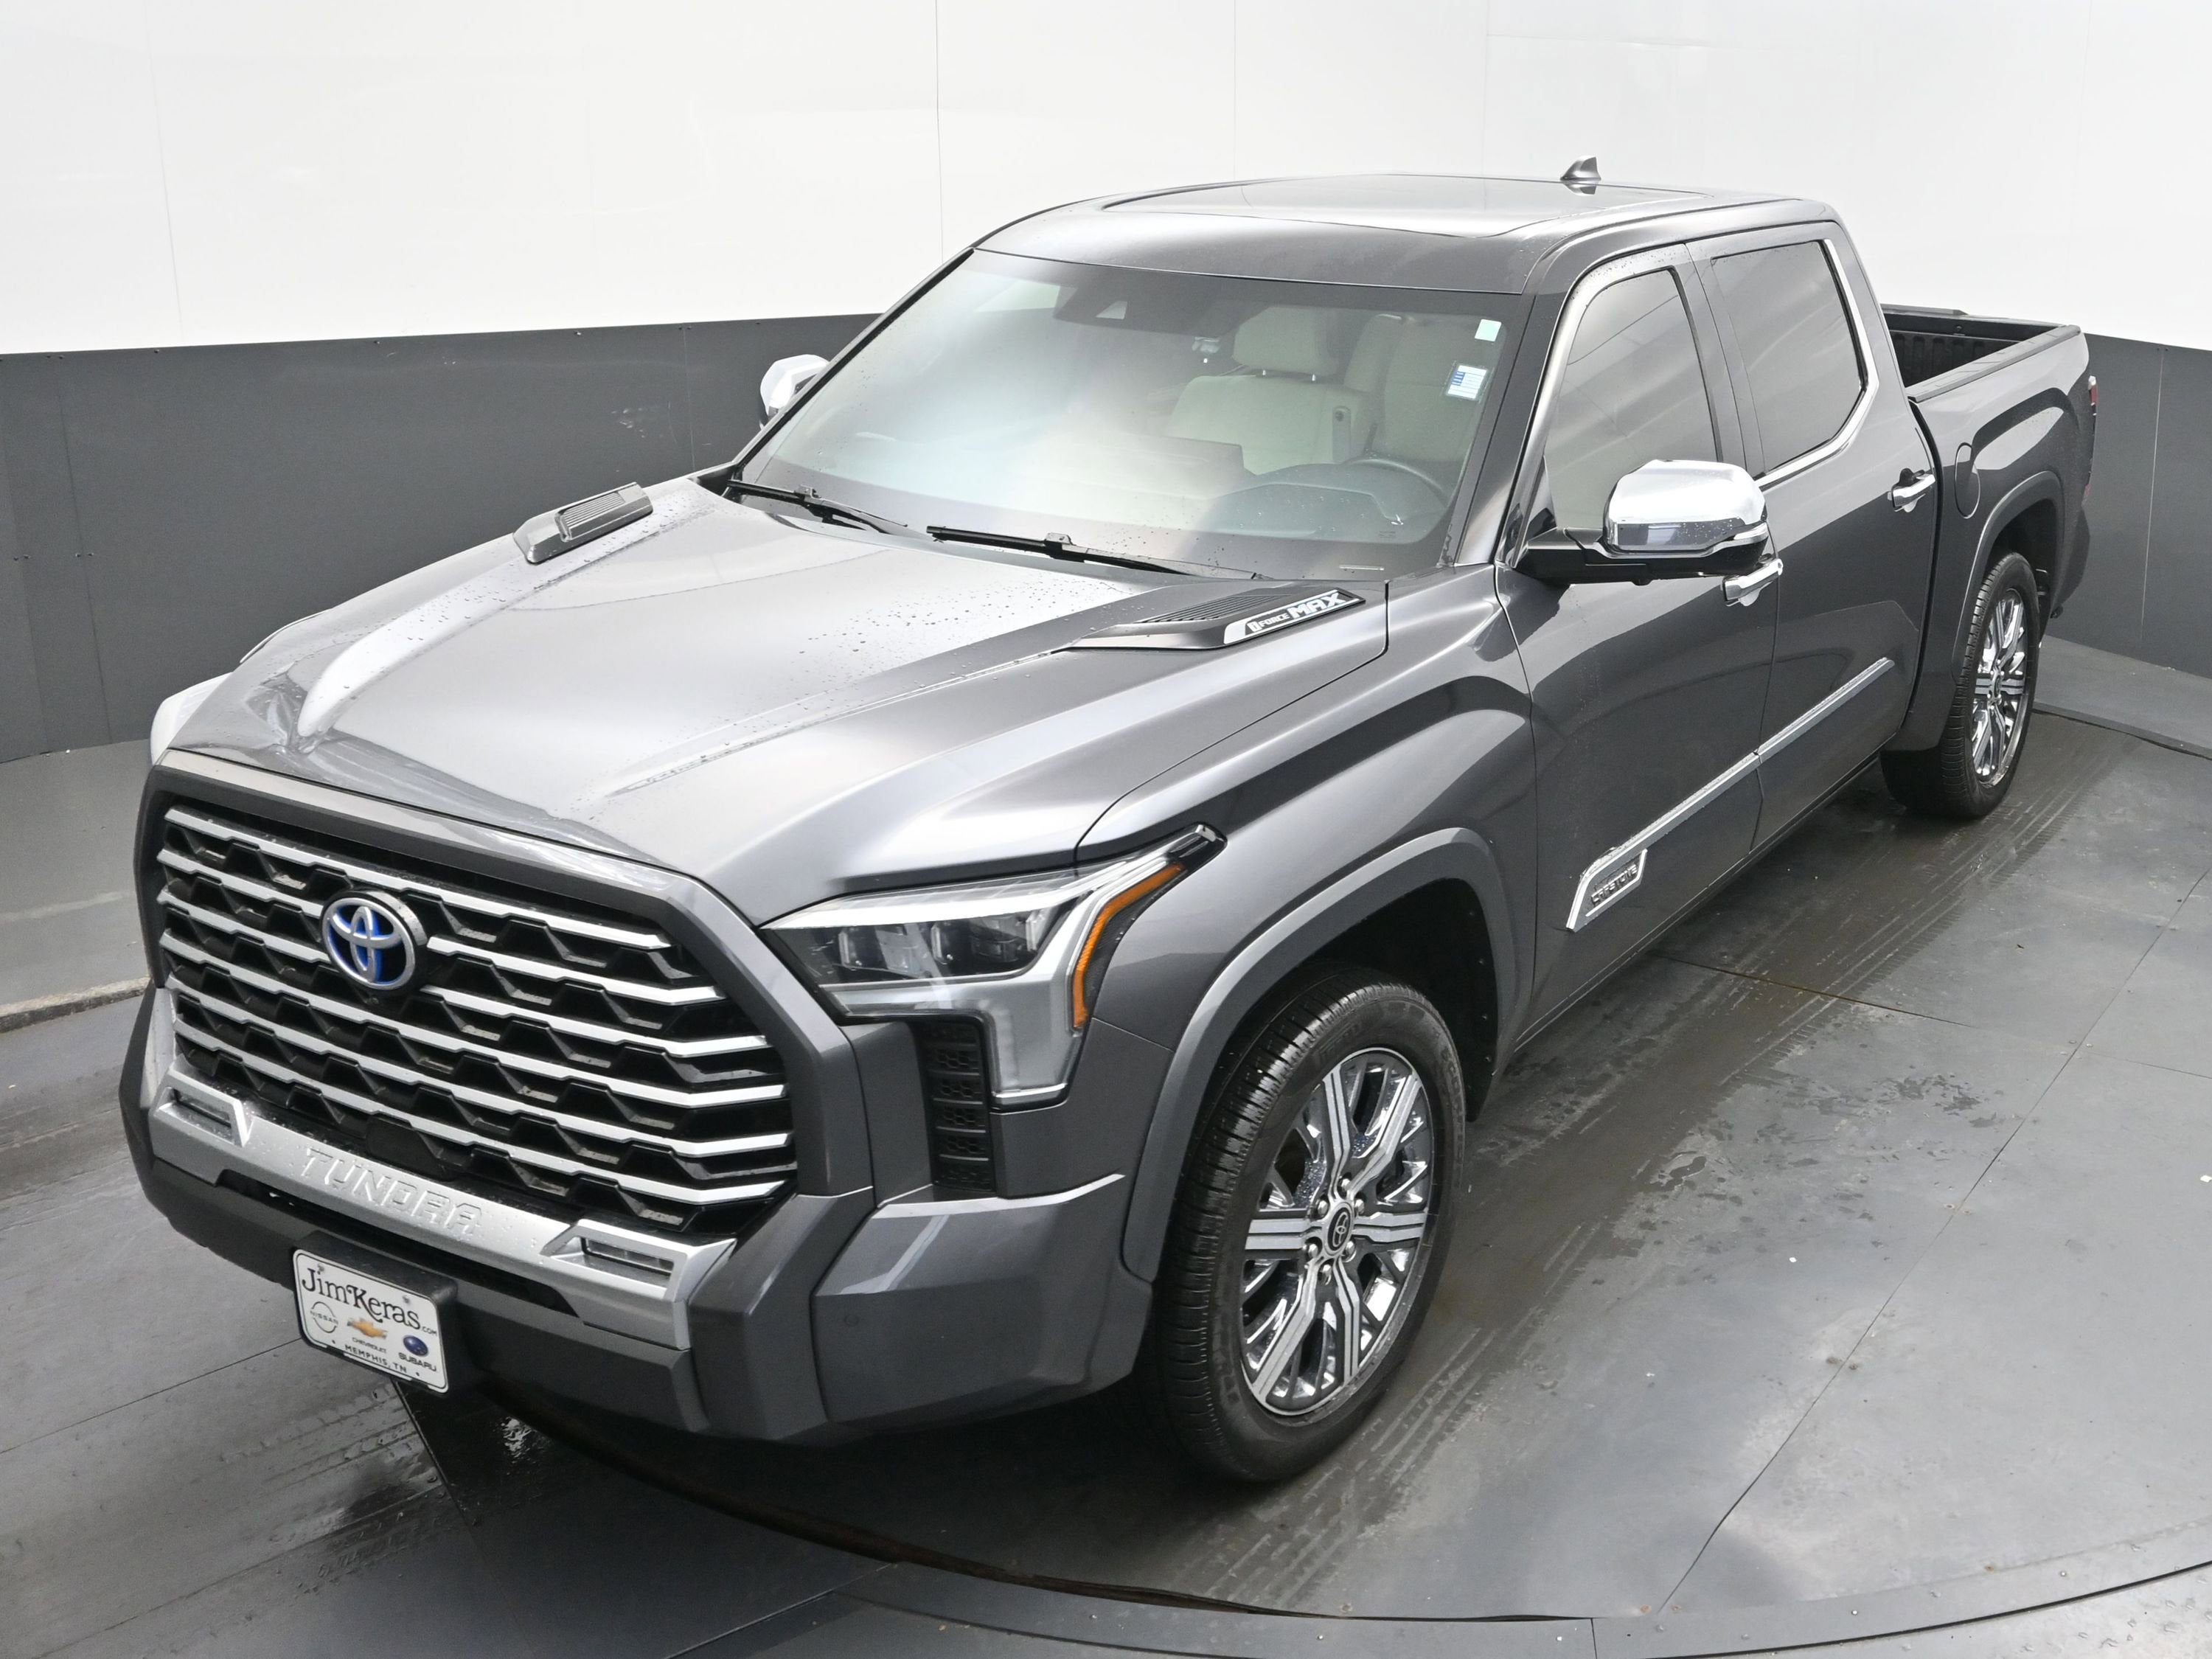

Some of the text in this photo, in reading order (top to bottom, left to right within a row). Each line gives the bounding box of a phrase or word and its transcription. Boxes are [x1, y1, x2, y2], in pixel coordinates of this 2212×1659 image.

[1287, 592, 1346, 619] MAX
[301, 1147, 482, 1237] TUNDRA
[392, 1362, 407, 1373] TN
[398, 1352, 437, 1372] SUBARU
